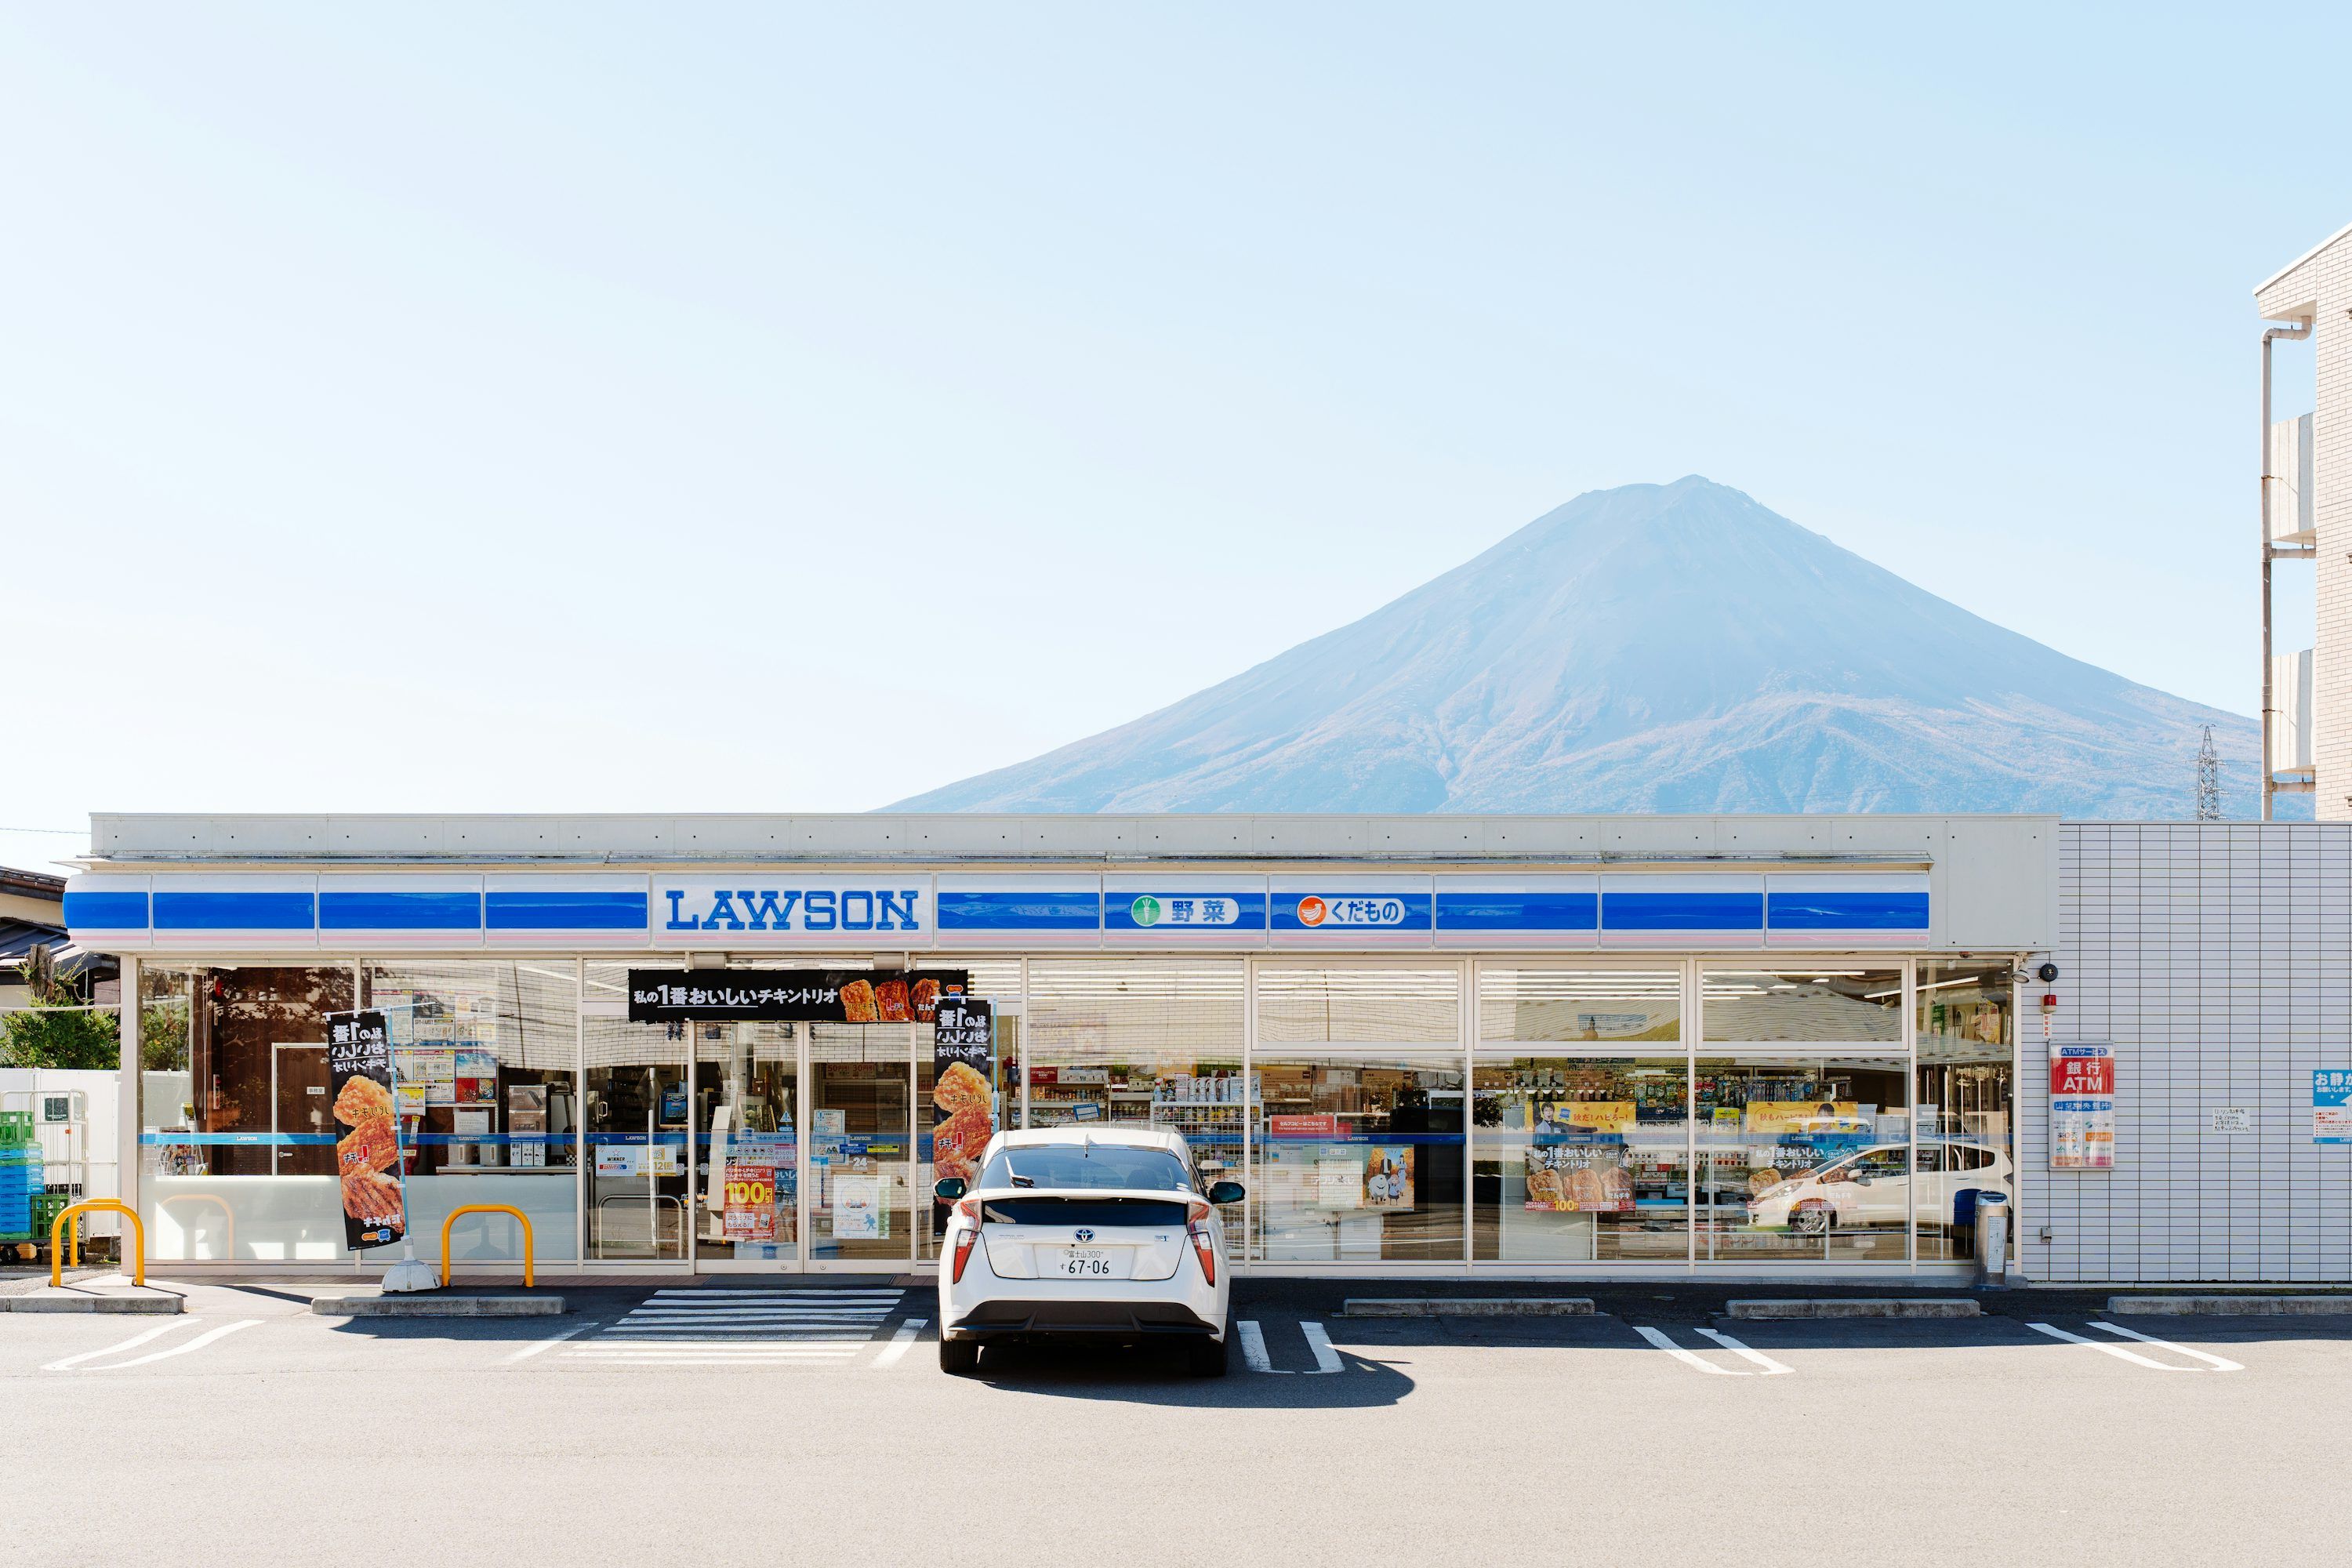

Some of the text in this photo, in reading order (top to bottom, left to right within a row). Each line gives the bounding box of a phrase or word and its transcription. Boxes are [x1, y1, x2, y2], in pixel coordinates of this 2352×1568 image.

[666, 891, 919, 930] LAWSON
[1171, 900, 1225, 923] 野菜
[1331, 901, 1399, 922] くだもの
[634, 985, 838, 1005] 私の1番おいしいチキントリオ
[2066, 1062, 2100, 1075] 銀行
[2063, 1077, 2102, 1091] ATM
[1534, 1146, 1602, 1158] 私の1番おいしい
[1545, 1160, 1591, 1168] チキントリオ
[1767, 1160, 1813, 1168] チキントリオ
[1069, 1260, 1109, 1274] 67-06
